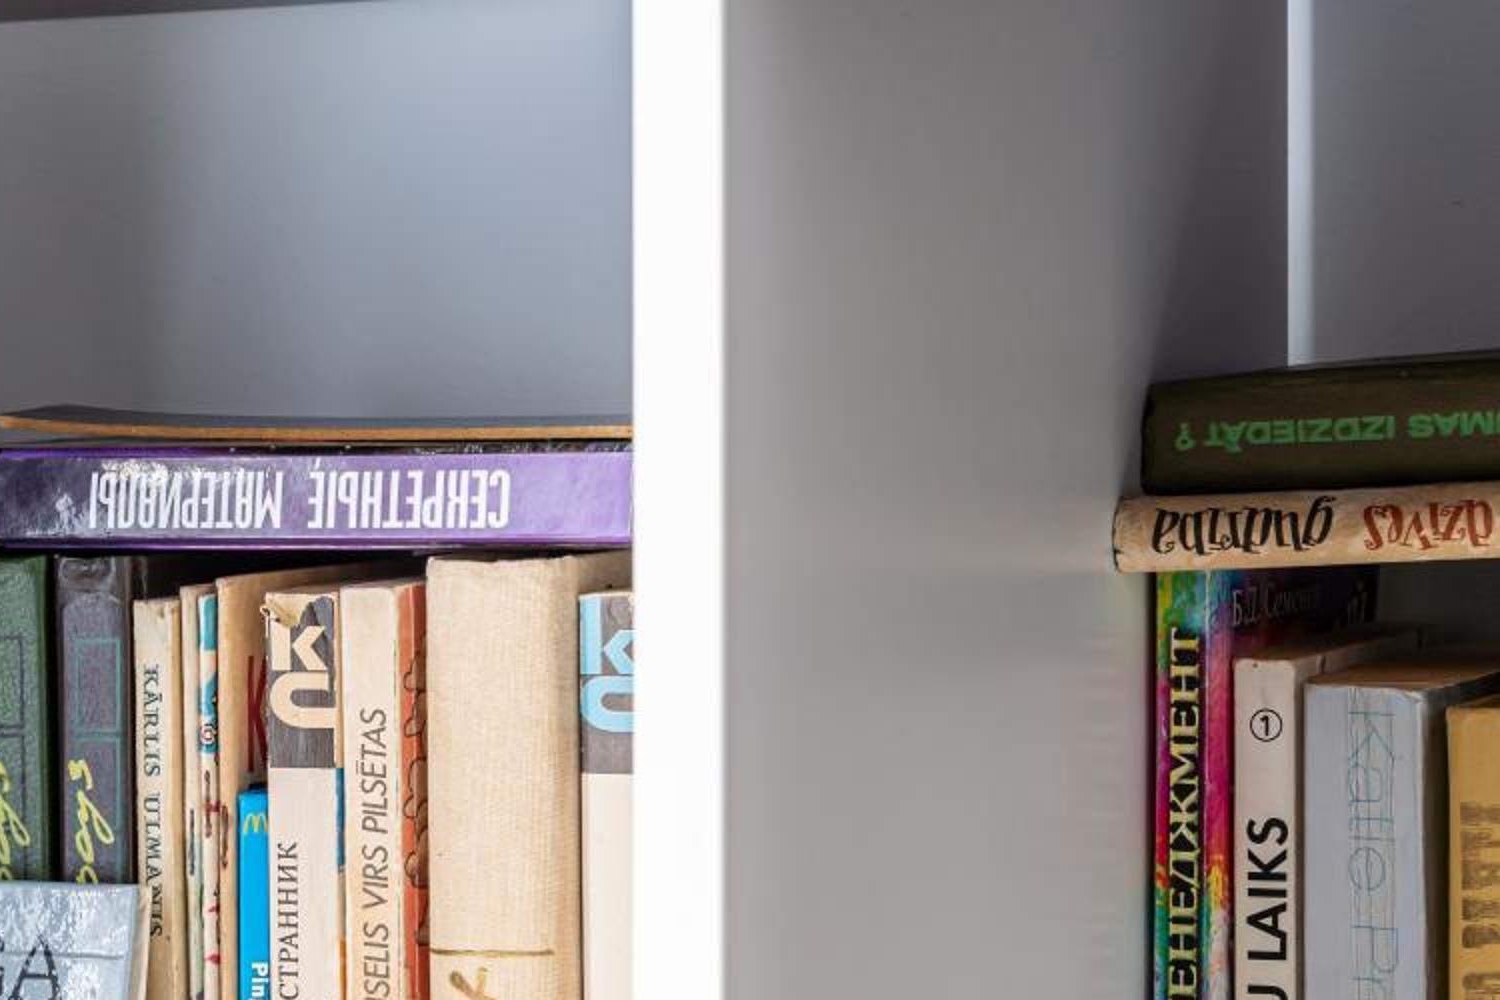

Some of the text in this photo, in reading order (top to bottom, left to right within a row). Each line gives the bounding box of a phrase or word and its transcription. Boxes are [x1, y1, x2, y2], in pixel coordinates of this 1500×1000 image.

[1174, 421, 1197, 452] ?
[1203, 415, 1396, 454] IZDZIEDĀT
[90, 468, 512, 531] СЕКРЕТНЫЕ МАТЕРИАЛЫ
[1151, 495, 1338, 558] gudrība
[143, 664, 164, 778] KĀRLIS
[355, 708, 388, 835] PILSĒTAS
[1348, 711, 1396, 892] Katie
[277, 841, 300, 1000] СТРАННИК
[361, 843, 389, 910] VIRS
[1247, 817, 1290, 962] LAIKS
